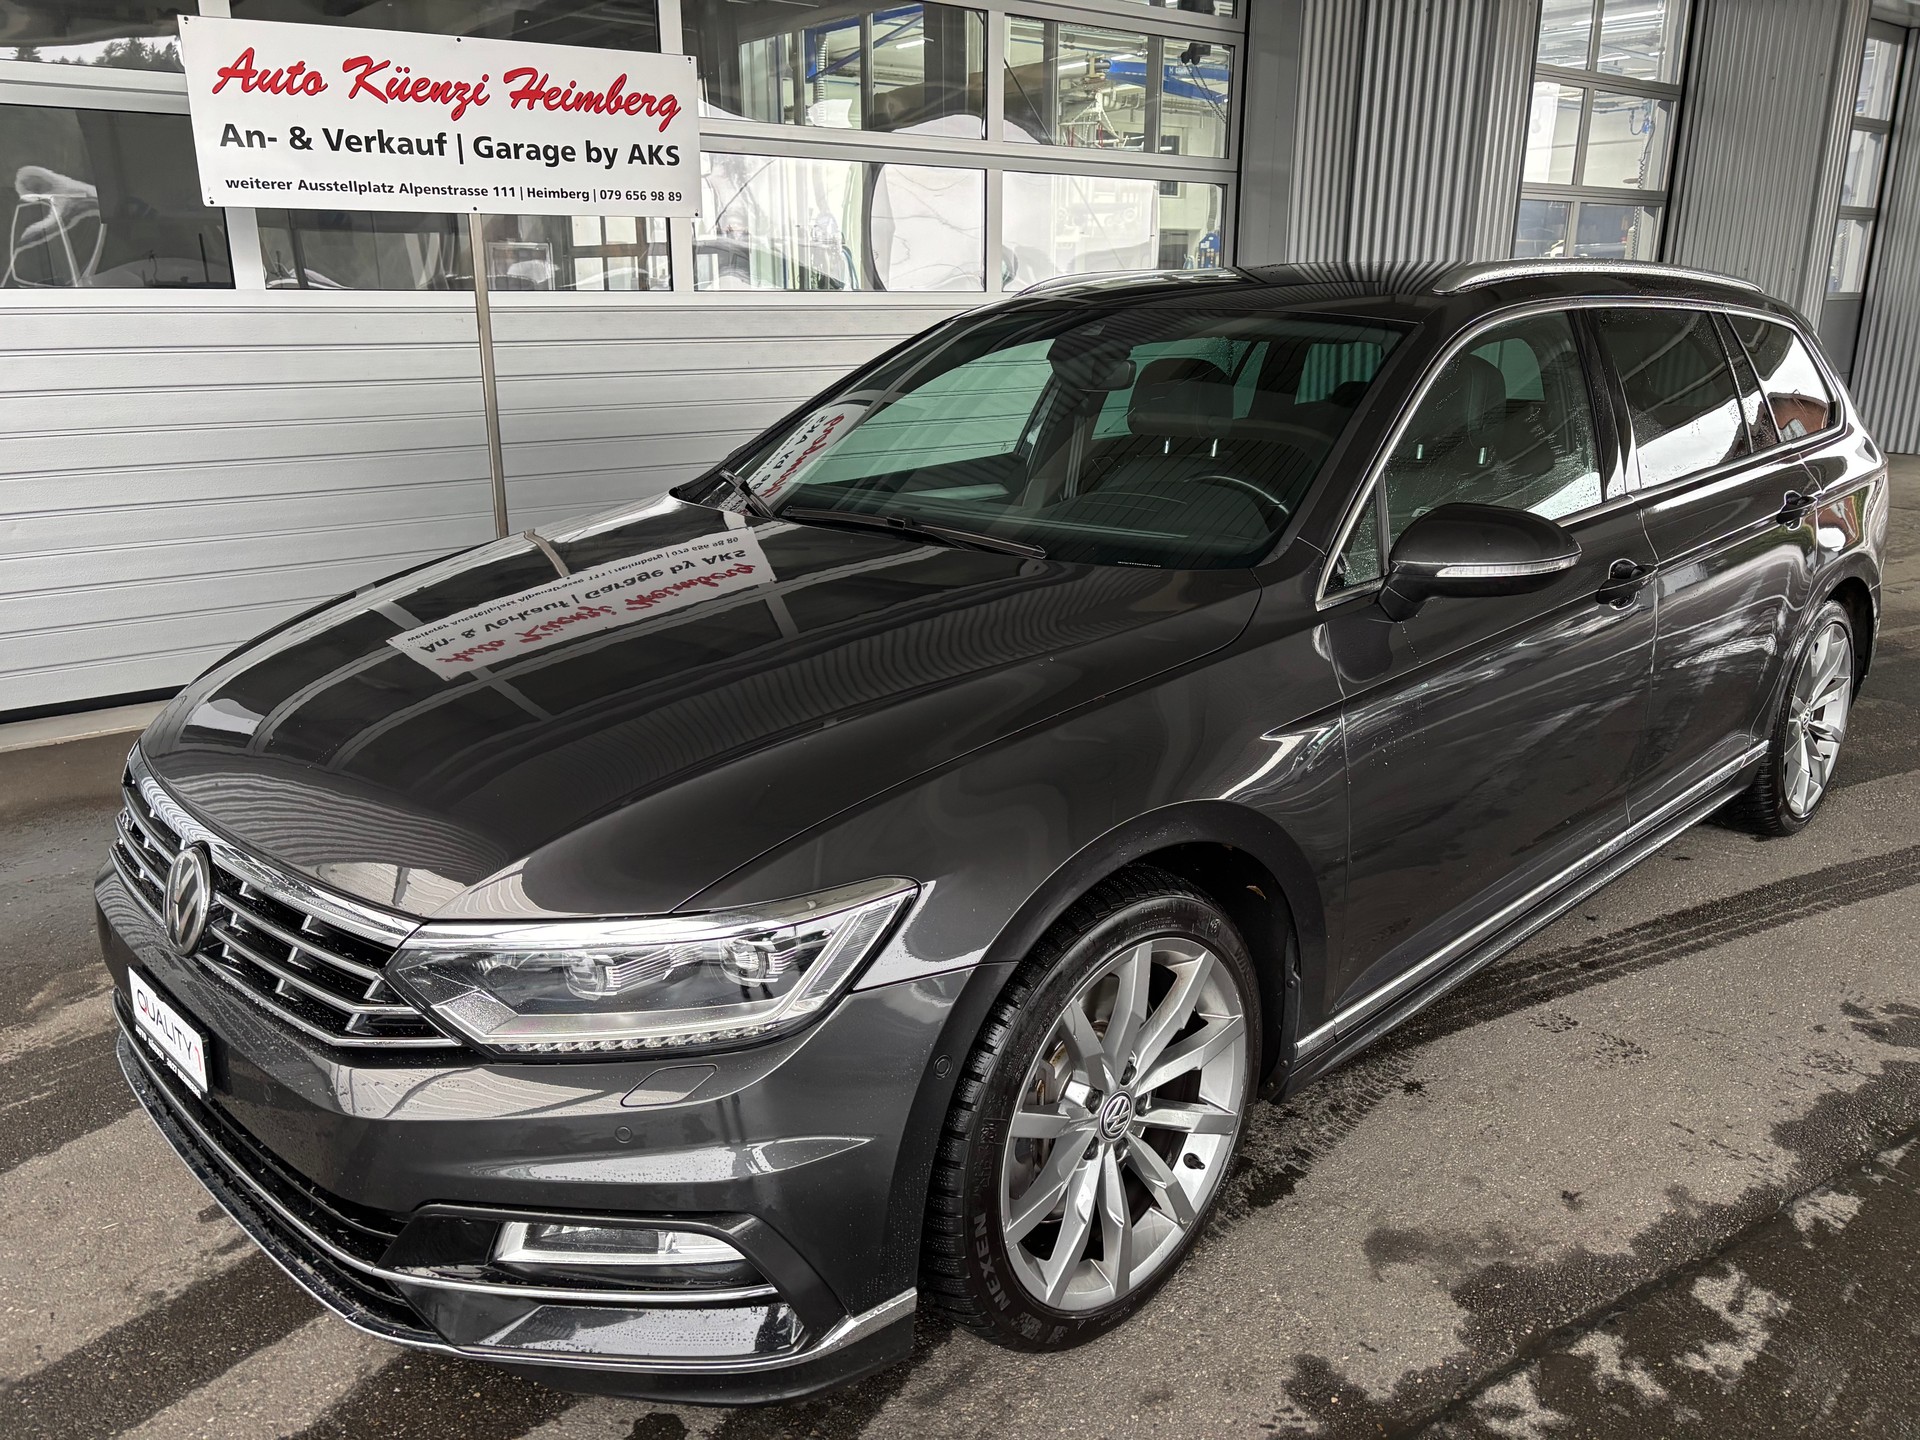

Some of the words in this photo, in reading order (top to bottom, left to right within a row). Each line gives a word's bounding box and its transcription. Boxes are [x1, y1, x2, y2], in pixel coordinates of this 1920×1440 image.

[212, 47, 328, 96] Auto
[342, 55, 490, 121] Küenzi
[503, 66, 681, 132] Heimberg
[220, 123, 278, 149] An-
[289, 125, 313, 151] &
[322, 127, 447, 157] Verkauf
[473, 135, 576, 168] Garage
[586, 139, 619, 170] by
[628, 143, 680, 167] AKS
[225, 178, 293, 191] weiterer
[298, 179, 395, 195] Ausstellplatz
[399, 182, 489, 198] Alpenstrasse
[493, 186, 516, 198] 111
[527, 187, 590, 202] Heimberg
[600, 189, 622, 201] 079
[625, 190, 647, 201] 656
[650, 190, 665, 202] 98
[668, 191, 683, 202] 89
[974, 1212, 1011, 1312] NEXEN
